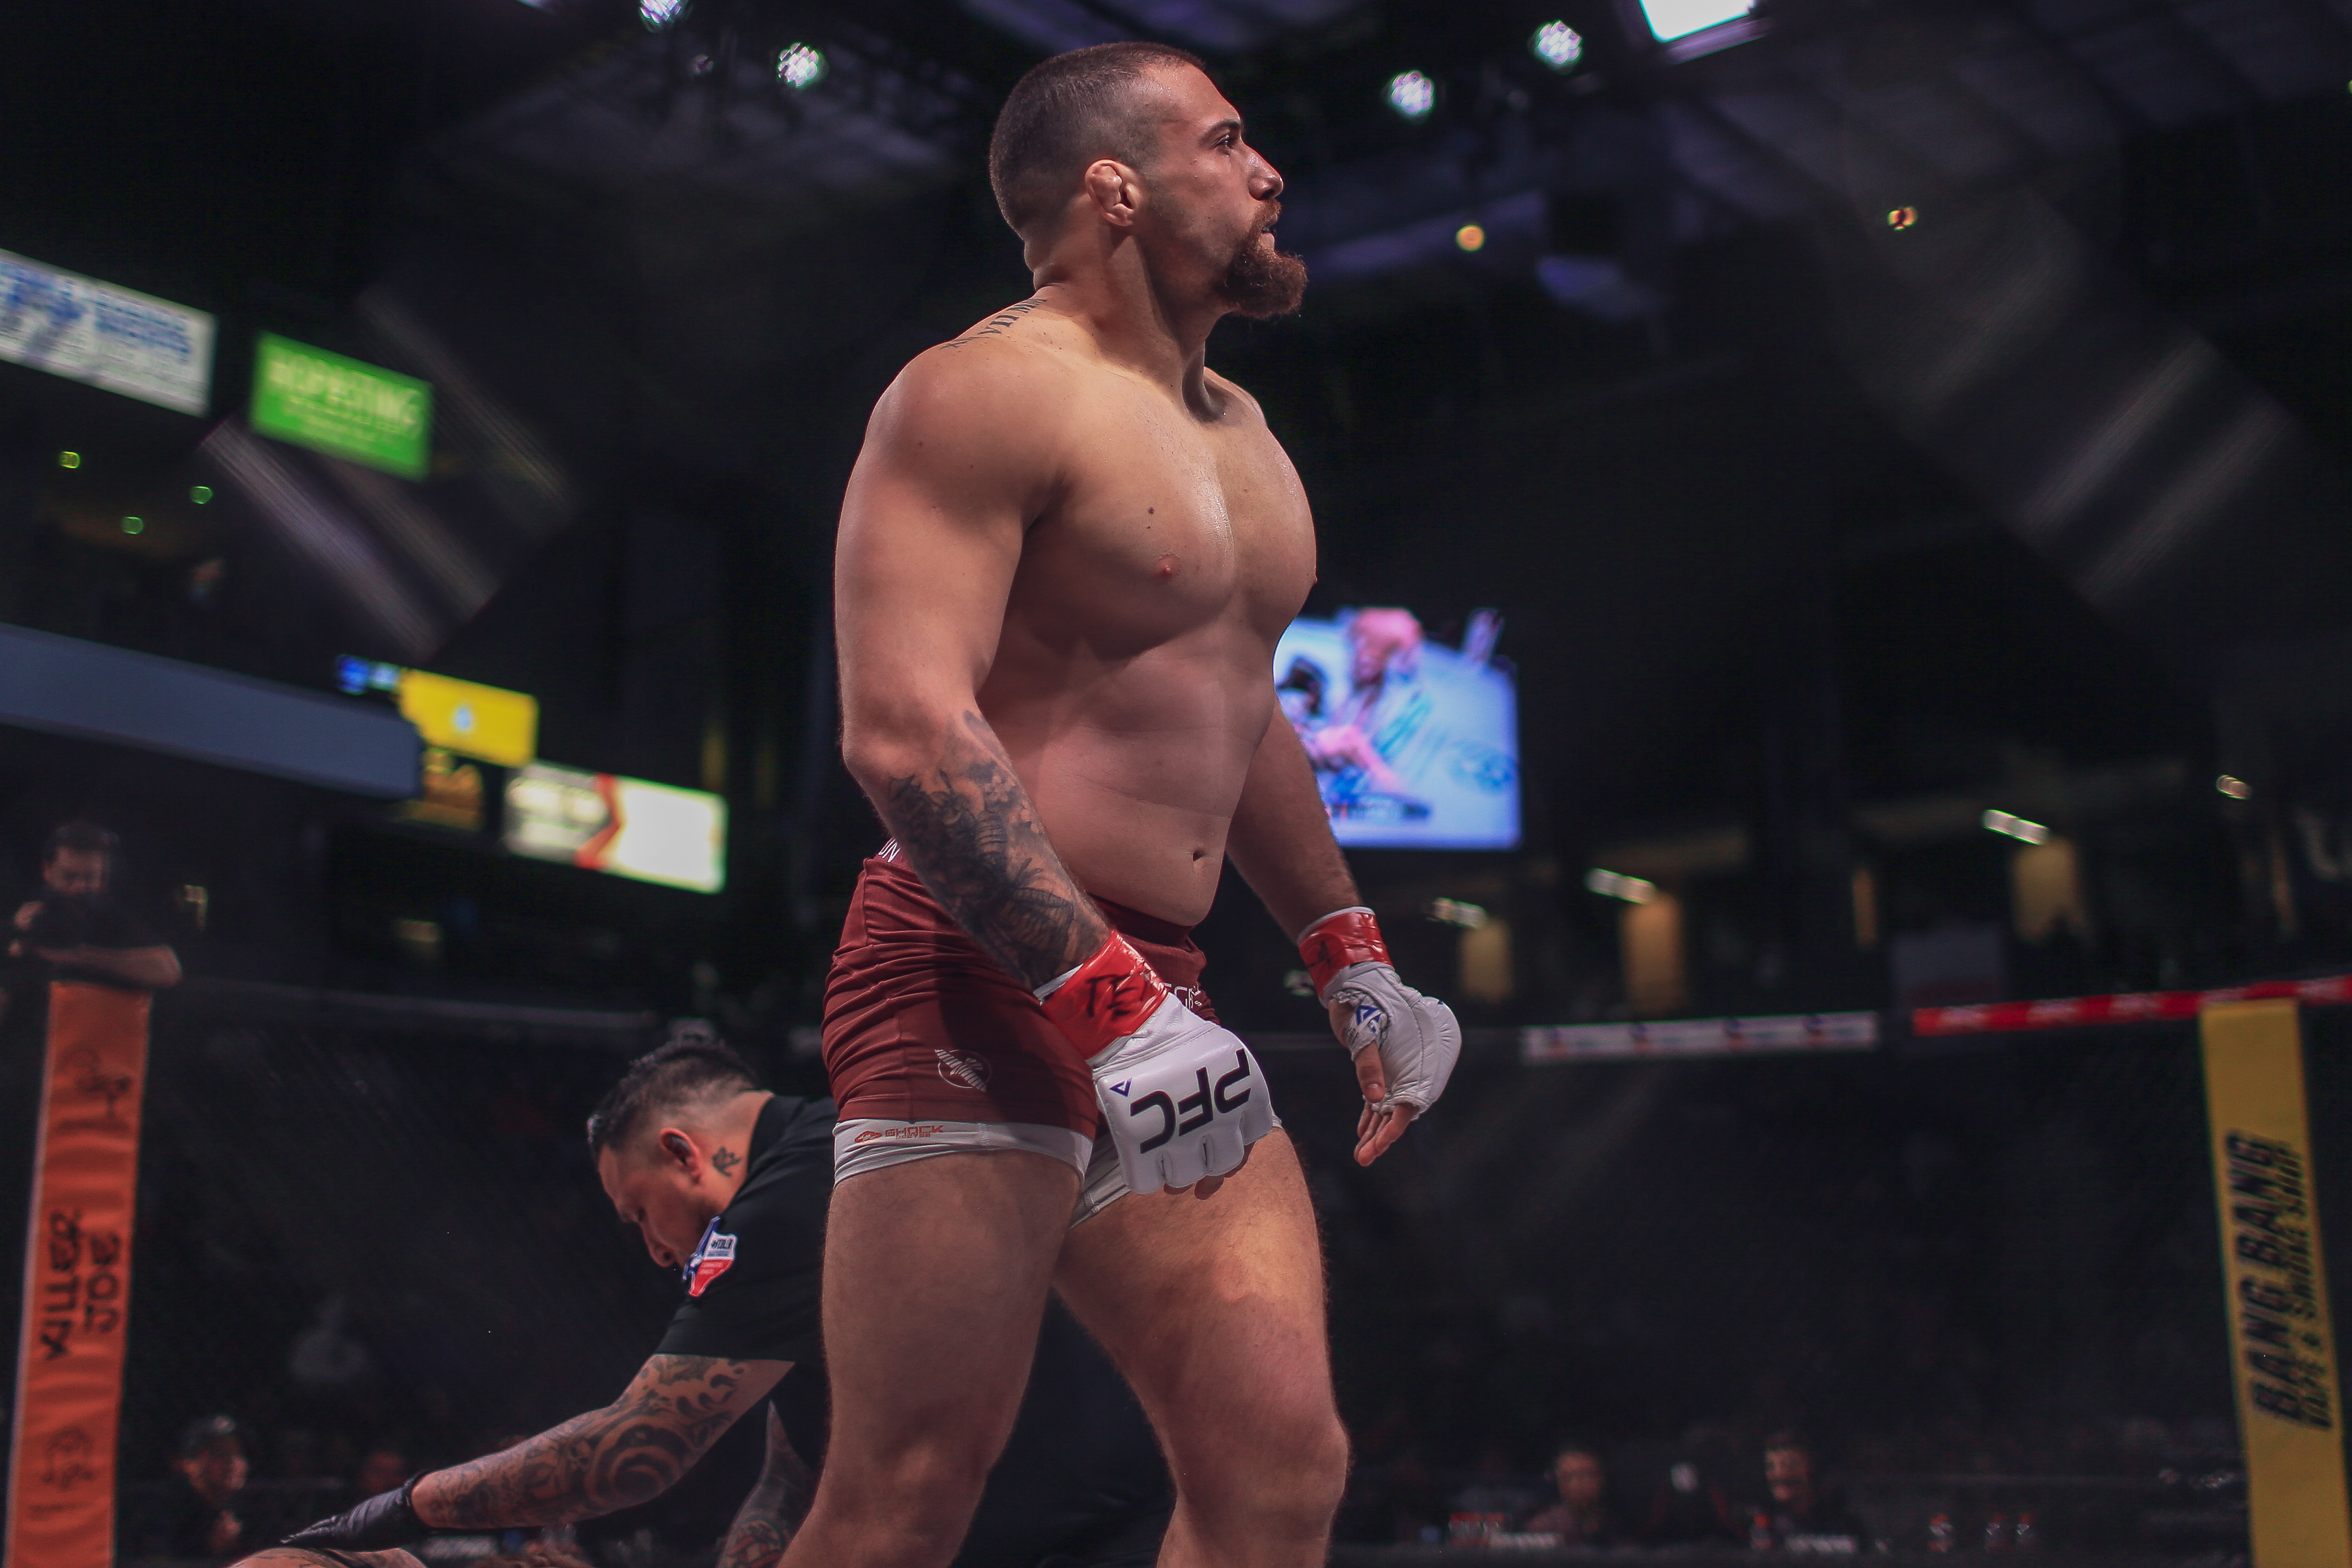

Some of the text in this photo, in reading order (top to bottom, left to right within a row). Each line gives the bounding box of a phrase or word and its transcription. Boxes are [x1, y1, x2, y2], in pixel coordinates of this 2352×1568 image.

[885, 1125, 944, 1137] SHOCK
[1129, 1048, 1253, 1154] PFC
[41, 1208, 81, 1359] KILLER
[85, 1230, 120, 1335] JOE
[2227, 1133, 2301, 1420] BANG BANG
